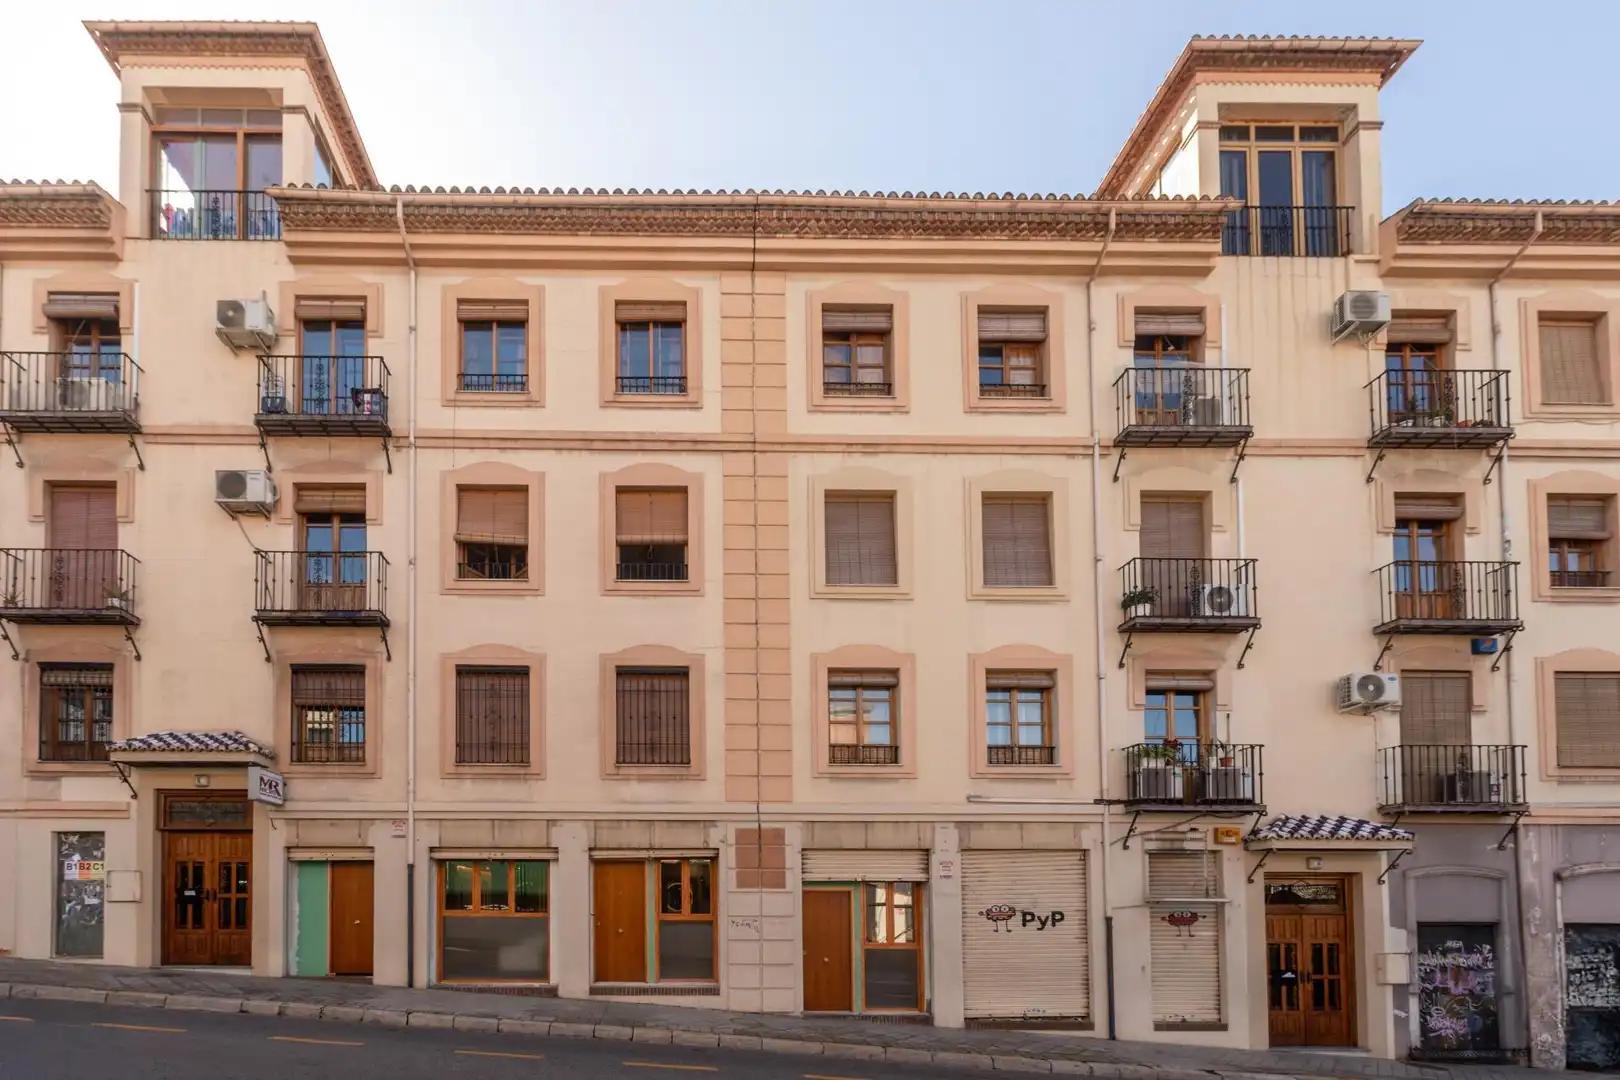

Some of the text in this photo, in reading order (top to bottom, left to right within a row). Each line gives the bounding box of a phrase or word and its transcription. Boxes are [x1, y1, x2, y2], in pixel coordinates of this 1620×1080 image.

[260, 776, 282, 797] MR
[66, 862, 104, 871] B1 B2 C1
[1021, 910, 1065, 931] PyP
